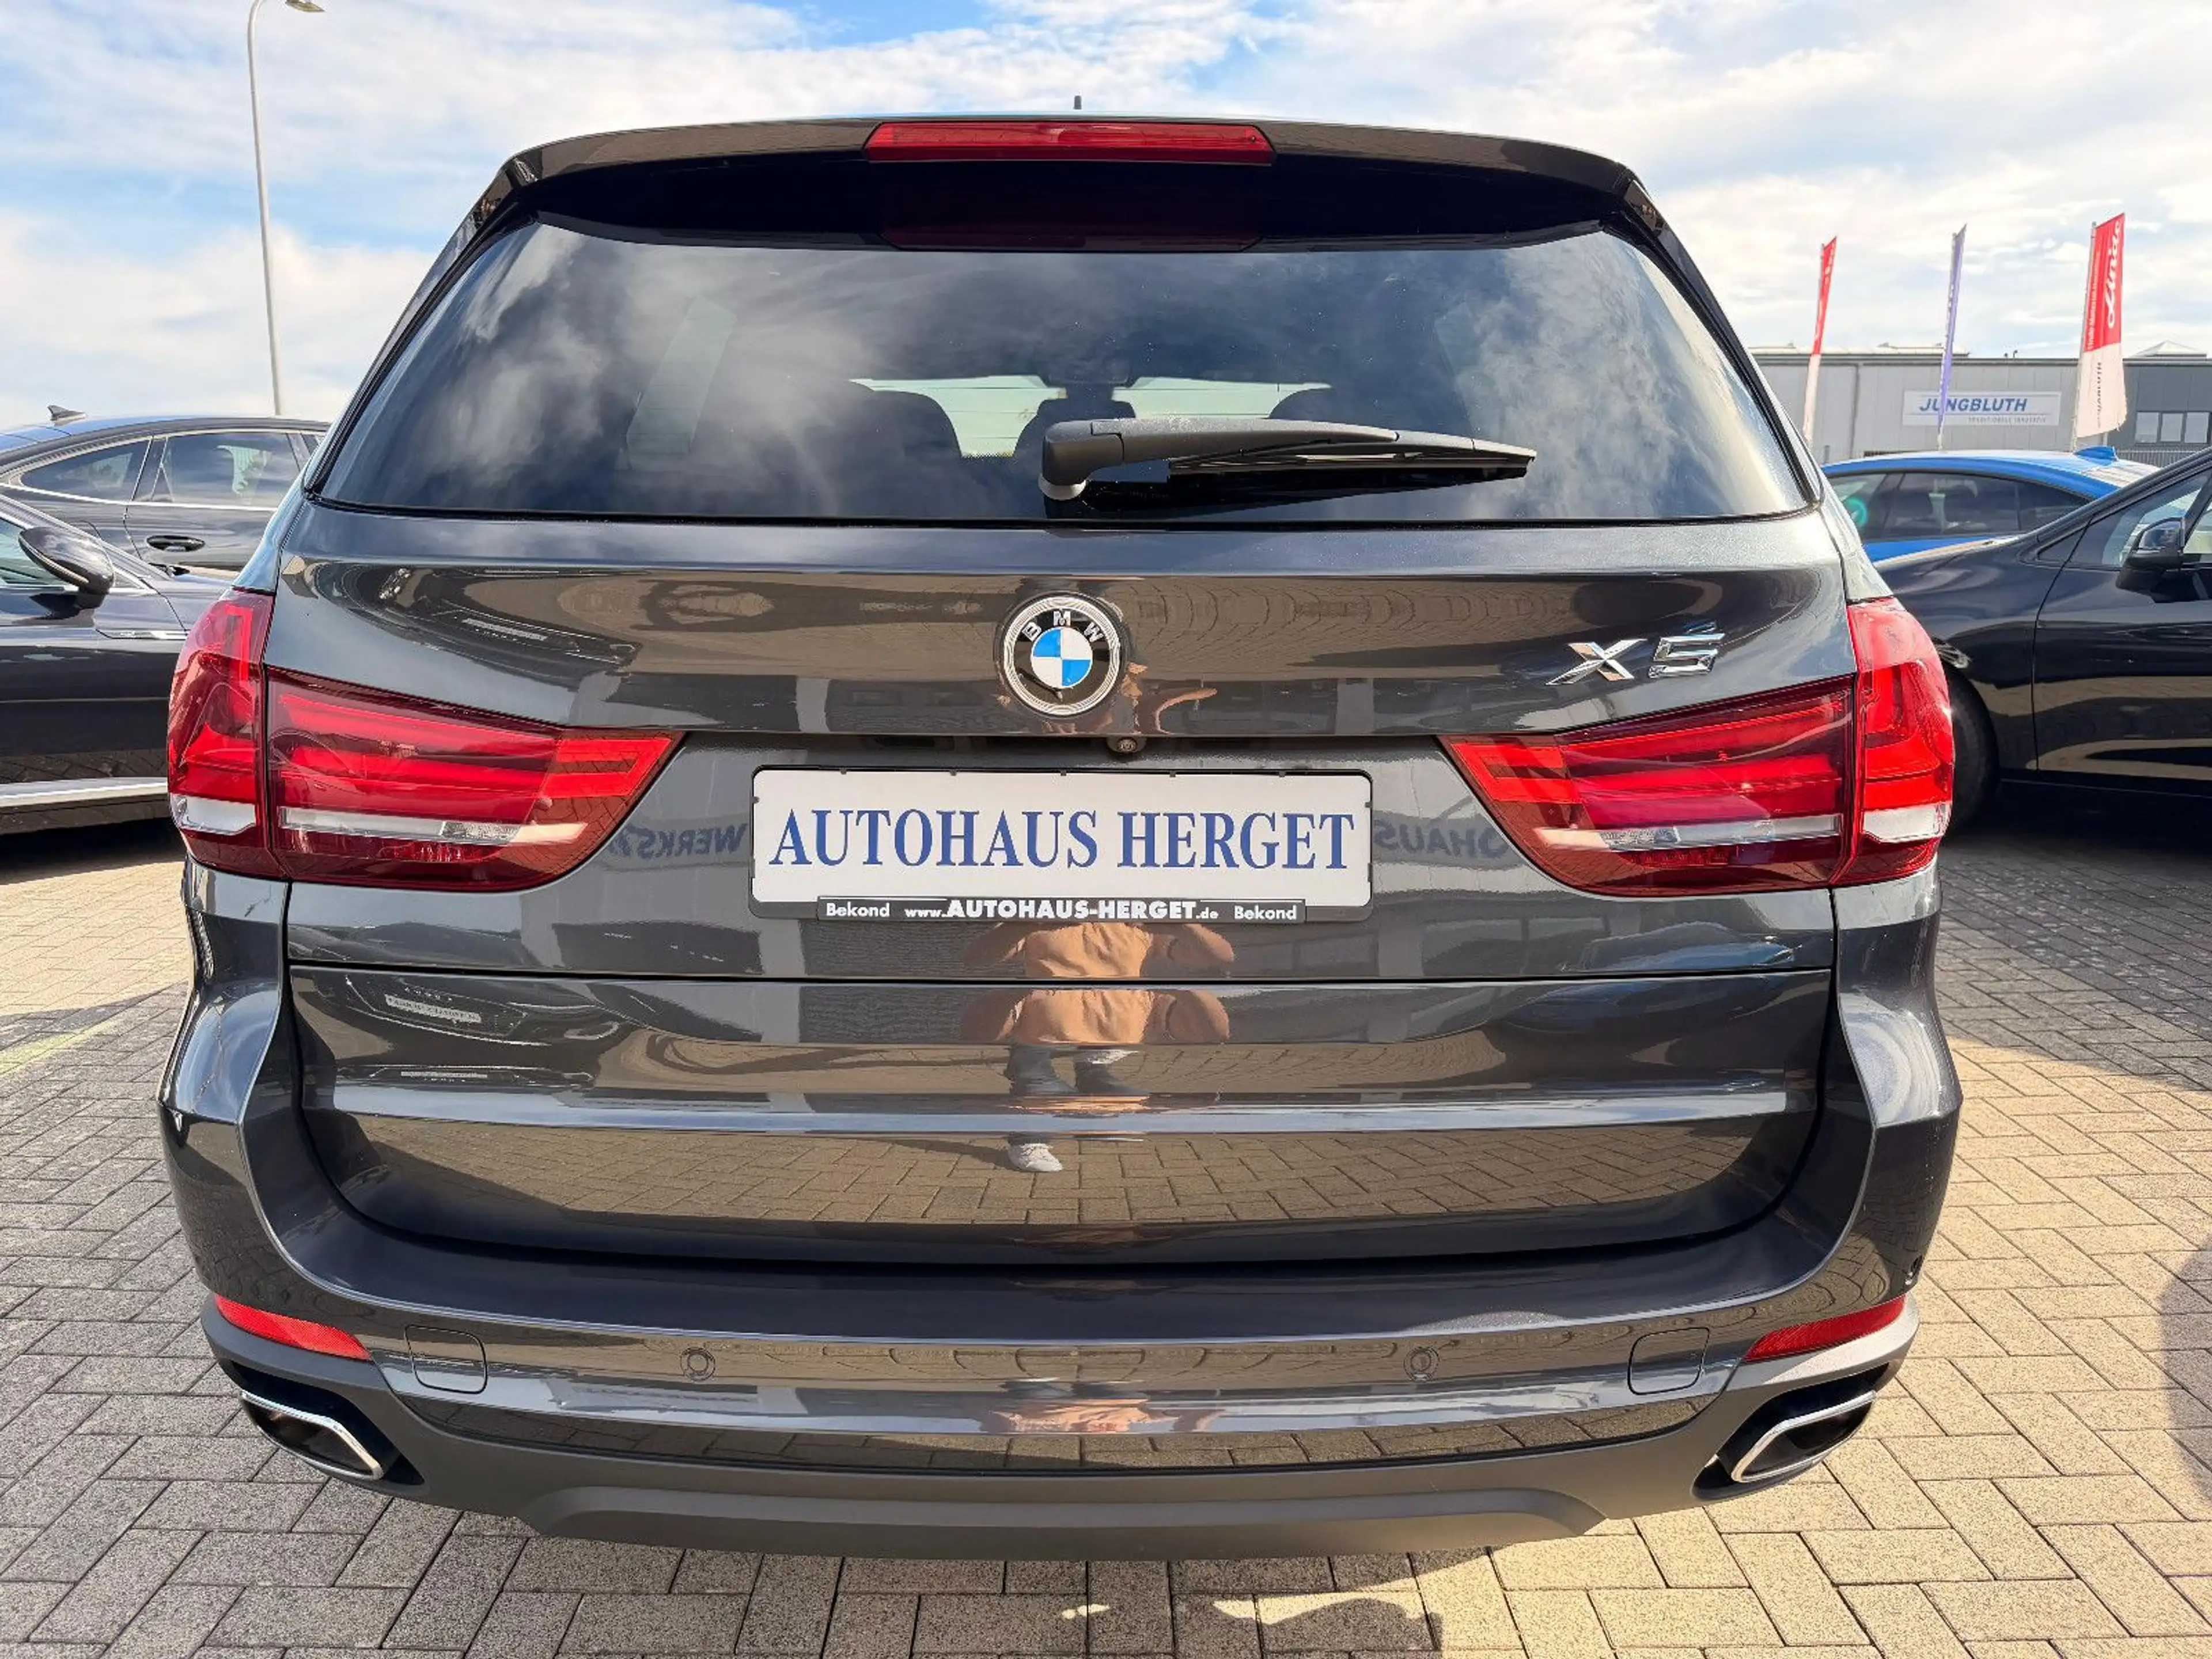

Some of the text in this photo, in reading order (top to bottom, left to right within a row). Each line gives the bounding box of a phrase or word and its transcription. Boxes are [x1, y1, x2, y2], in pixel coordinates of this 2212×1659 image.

[1022, 611, 1104, 642] BMW
[1546, 632, 1726, 686] X5
[768, 808, 1355, 869] AUTOHAUS HERGET
[825, 899, 1297, 921] Bekond www.AUTOHAUS-HERGET.de Bekond
